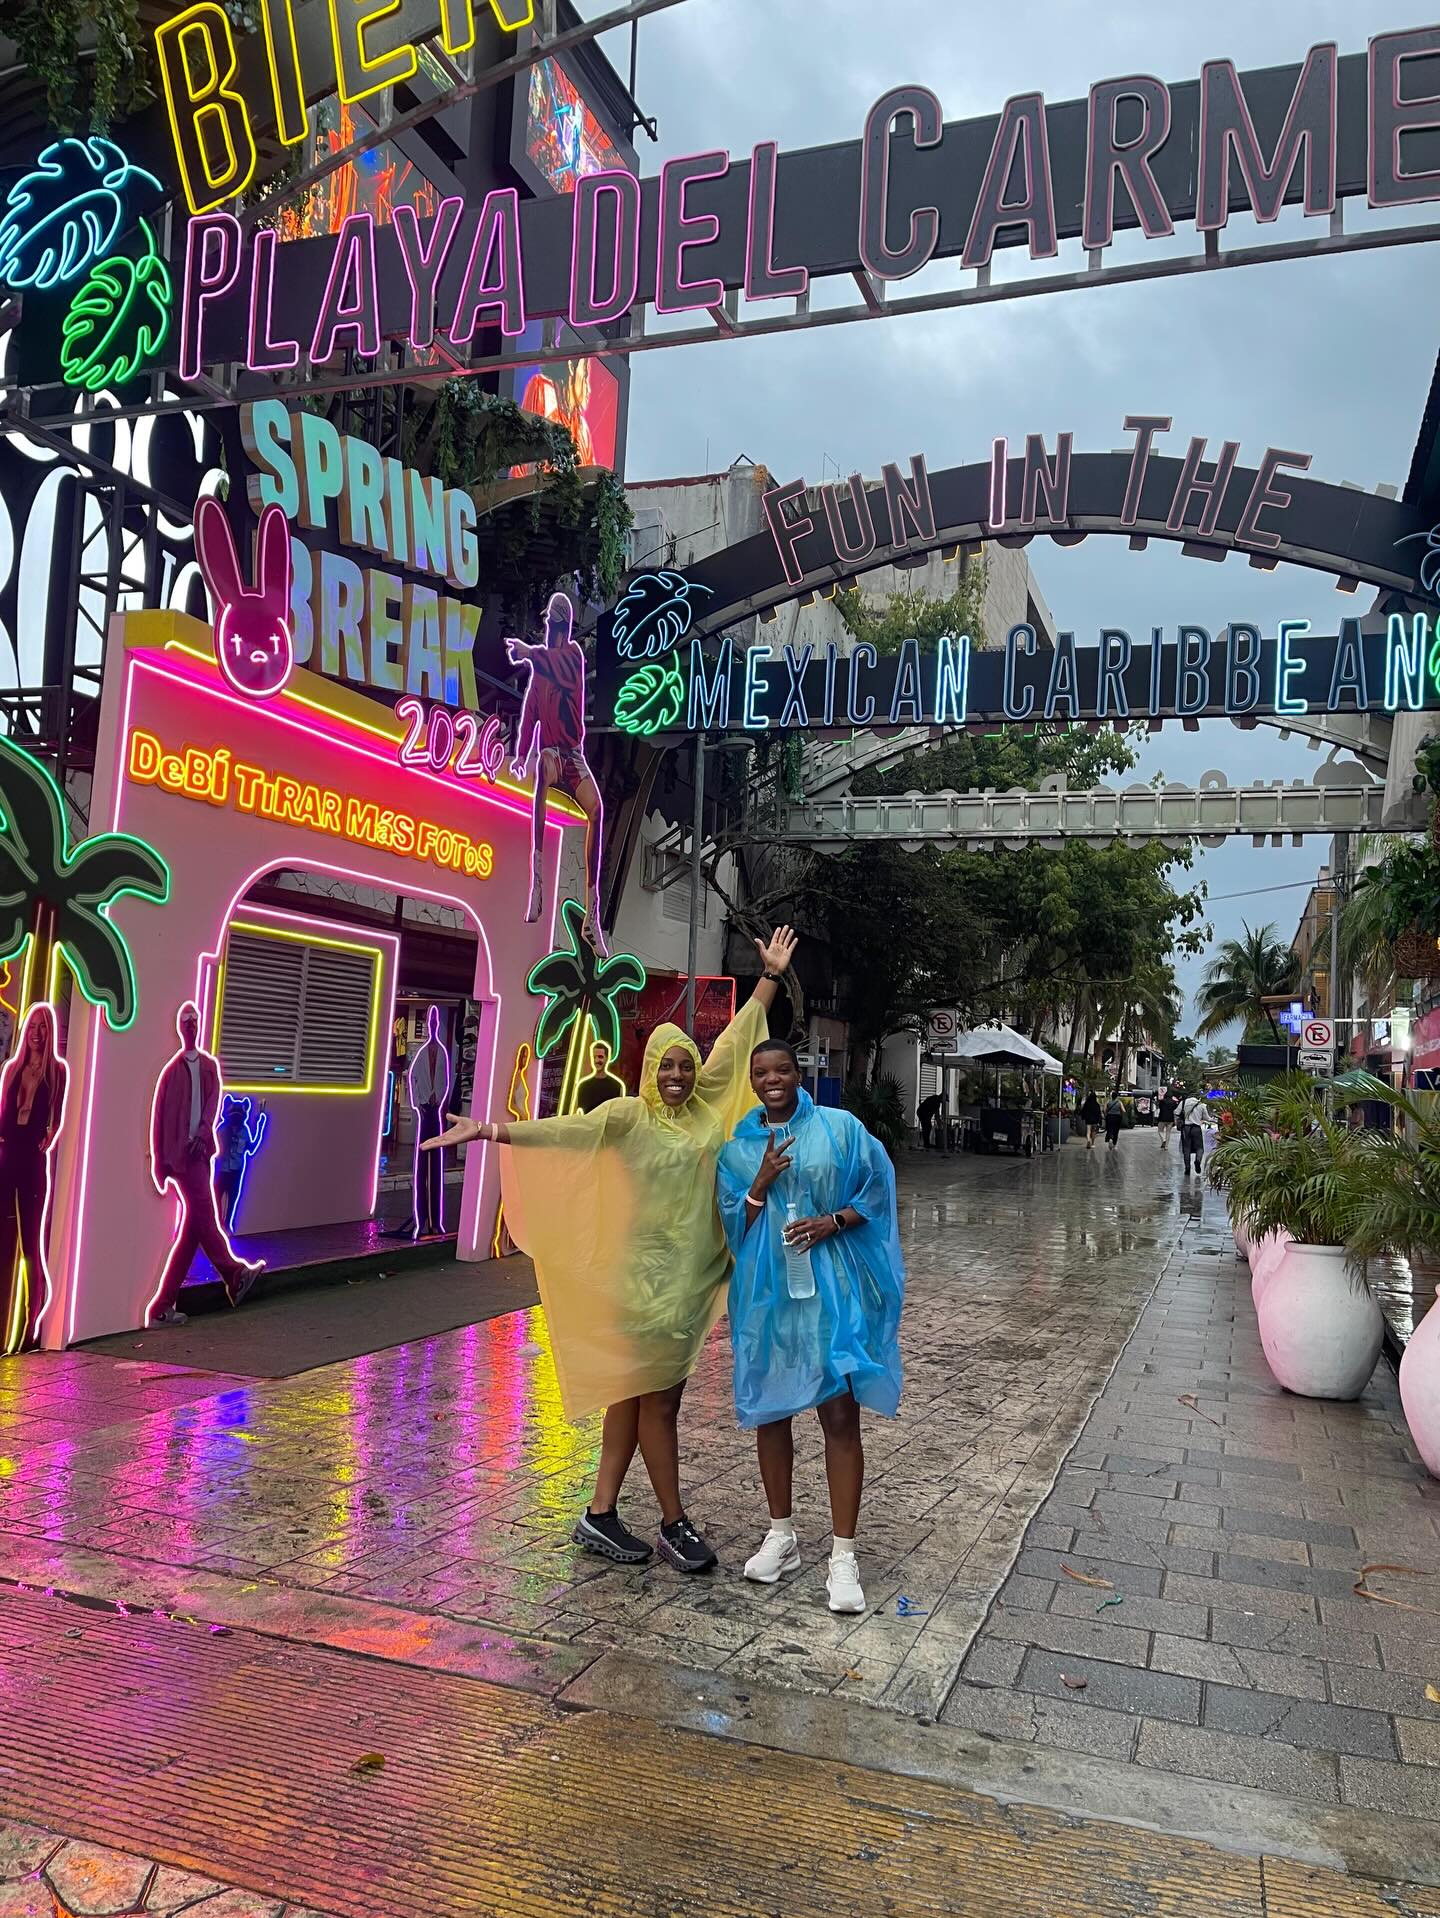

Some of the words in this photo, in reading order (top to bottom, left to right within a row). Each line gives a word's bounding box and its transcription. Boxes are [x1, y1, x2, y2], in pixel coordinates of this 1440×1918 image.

[153, 0, 536, 216] BIE
[179, 188, 527, 382] PLAYA
[567, 139, 810, 328] DEL
[240, 399, 479, 590] SPRING
[761, 453, 937, 587] FUN
[987, 431, 1073, 530] IN
[1119, 415, 1313, 549] THE
[396, 696, 505, 782] 2026
[686, 633, 971, 731] MEXICAN
[1001, 611, 1429, 722] CARIBBEAN
